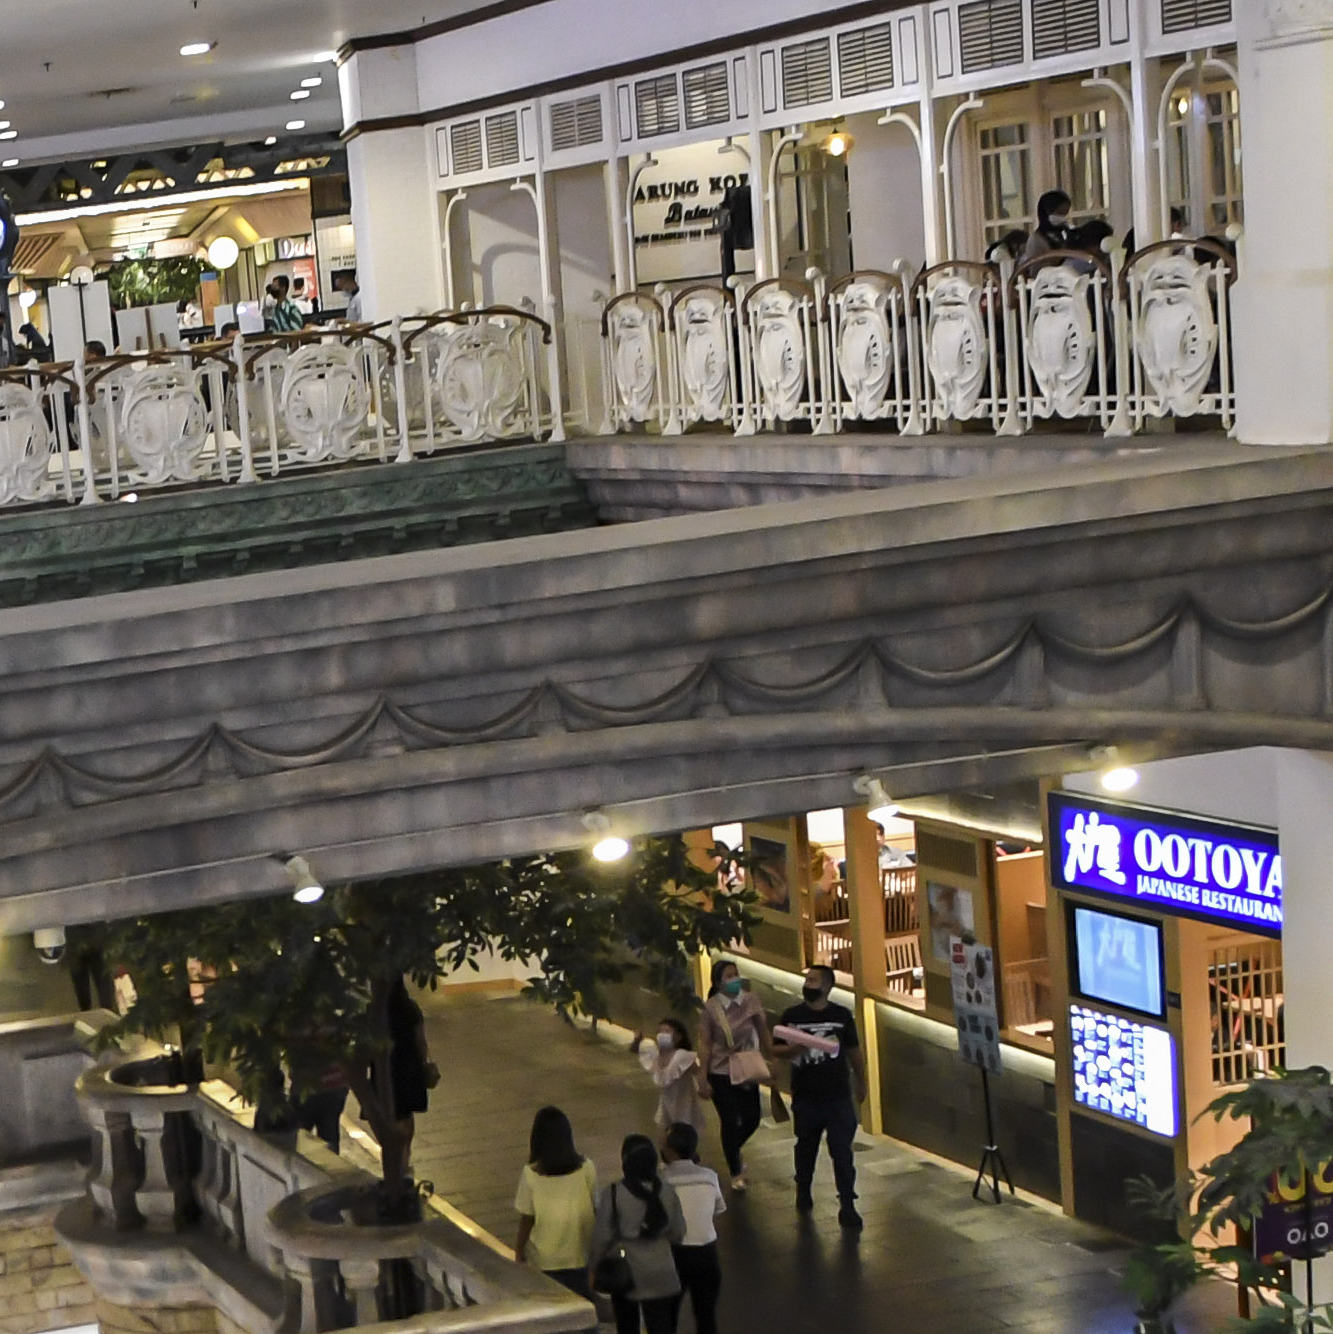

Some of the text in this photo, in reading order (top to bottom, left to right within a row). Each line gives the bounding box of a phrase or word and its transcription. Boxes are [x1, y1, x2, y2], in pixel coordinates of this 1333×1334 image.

[634, 180, 700, 201] ARUNG
[1133, 828, 1282, 898] OOTOYA
[1137, 874, 1282, 923] JAPANESE RESTAURAN
